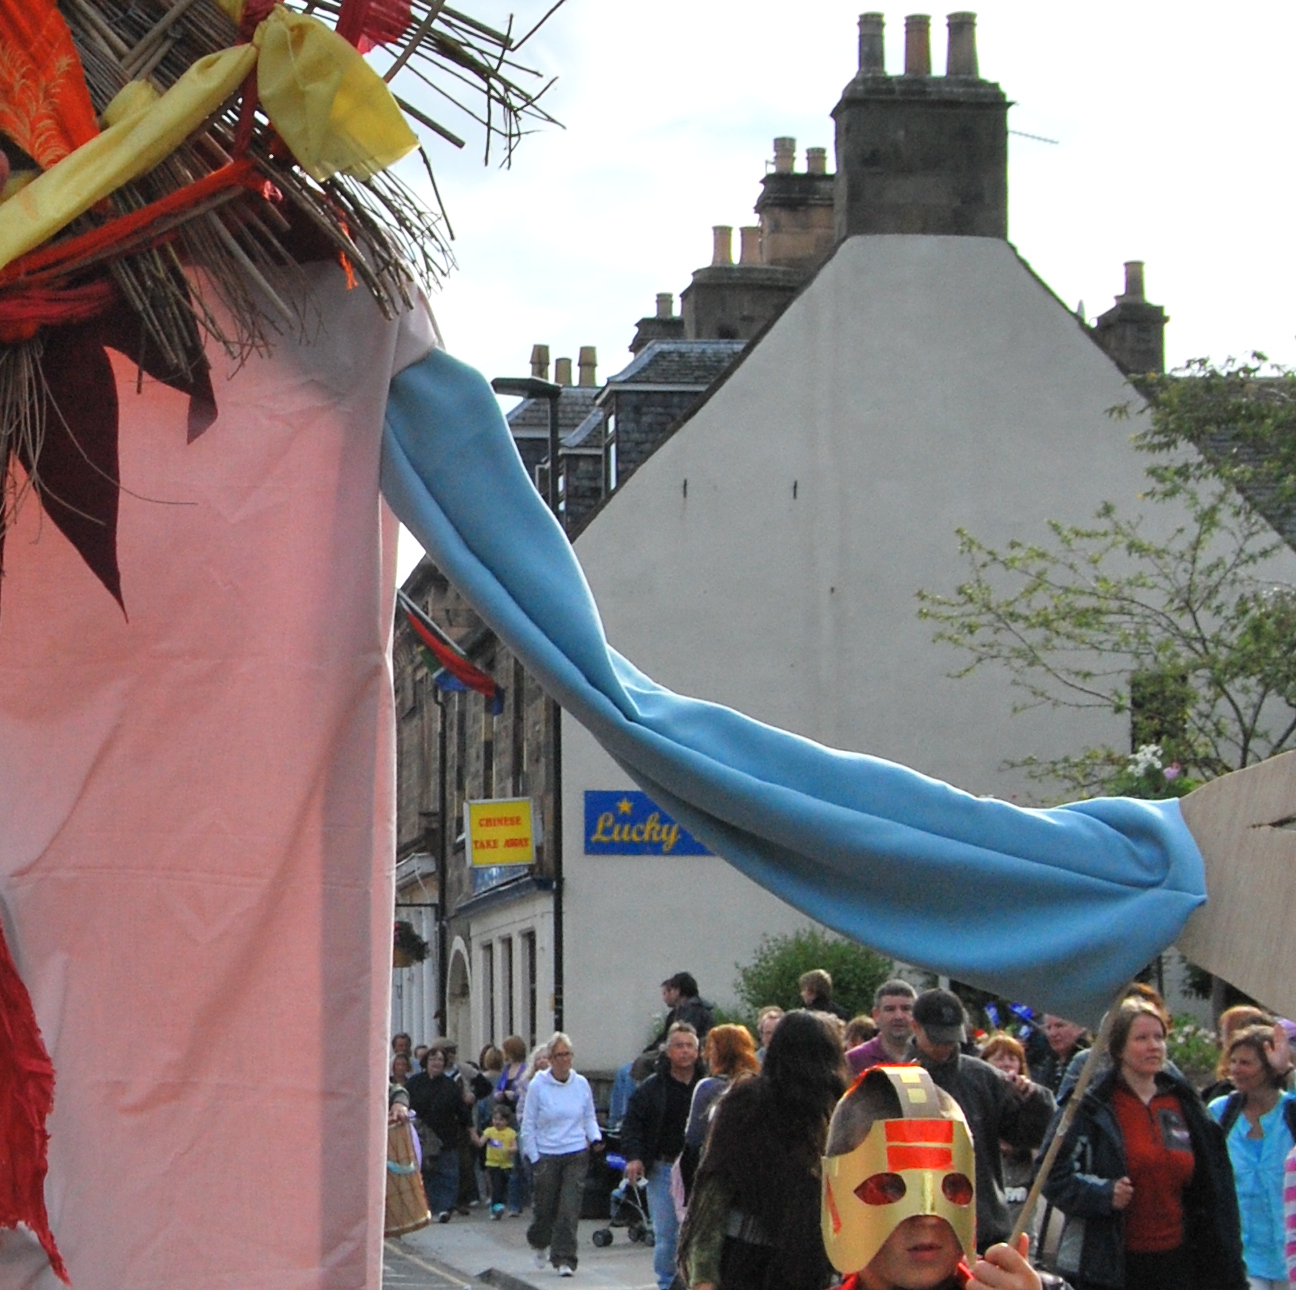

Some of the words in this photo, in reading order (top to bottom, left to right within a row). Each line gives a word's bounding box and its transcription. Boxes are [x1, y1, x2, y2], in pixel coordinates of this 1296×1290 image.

[478, 816, 522, 827] CHINESE
[591, 812, 681, 852] Lucky
[473, 839, 499, 850] TAKE
[504, 837, 529, 849] AWAY
